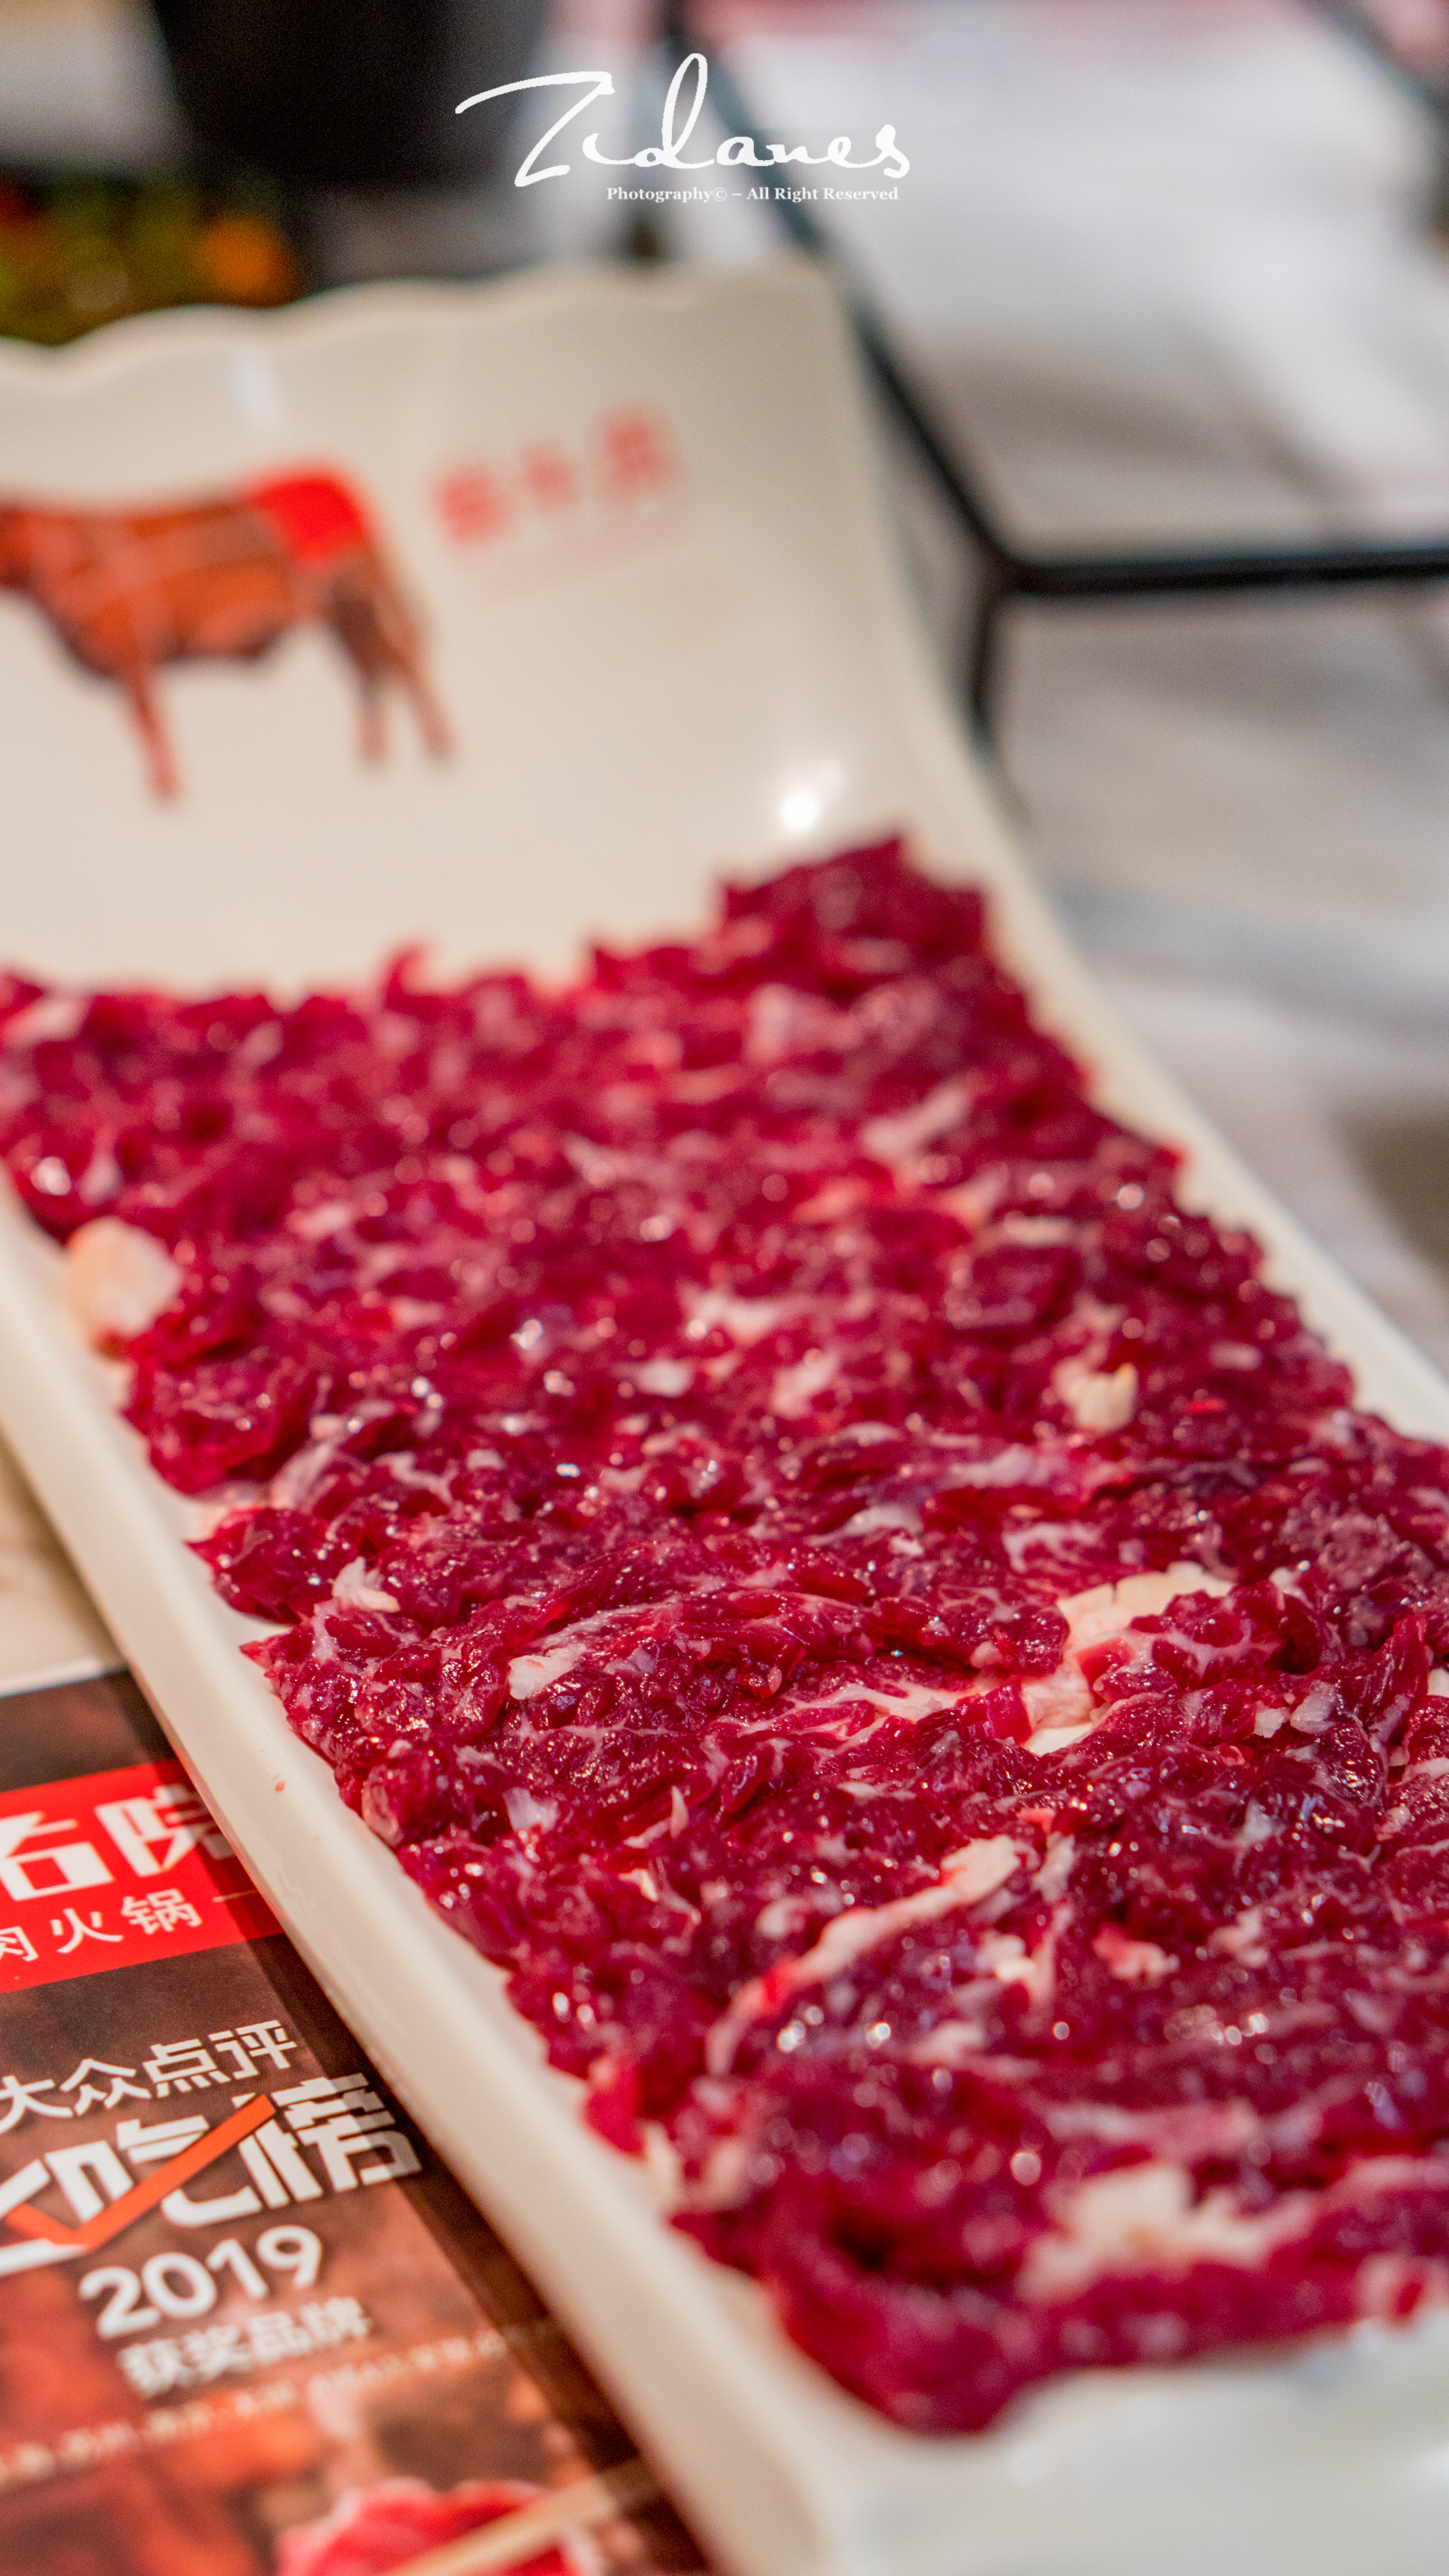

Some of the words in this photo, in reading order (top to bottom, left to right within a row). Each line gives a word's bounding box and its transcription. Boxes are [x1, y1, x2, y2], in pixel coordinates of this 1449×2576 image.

[0, 2019, 297, 2135] 大众点评
[79, 2225, 323, 2339] 2019
[117, 2296, 372, 2398] 获奖品牌
